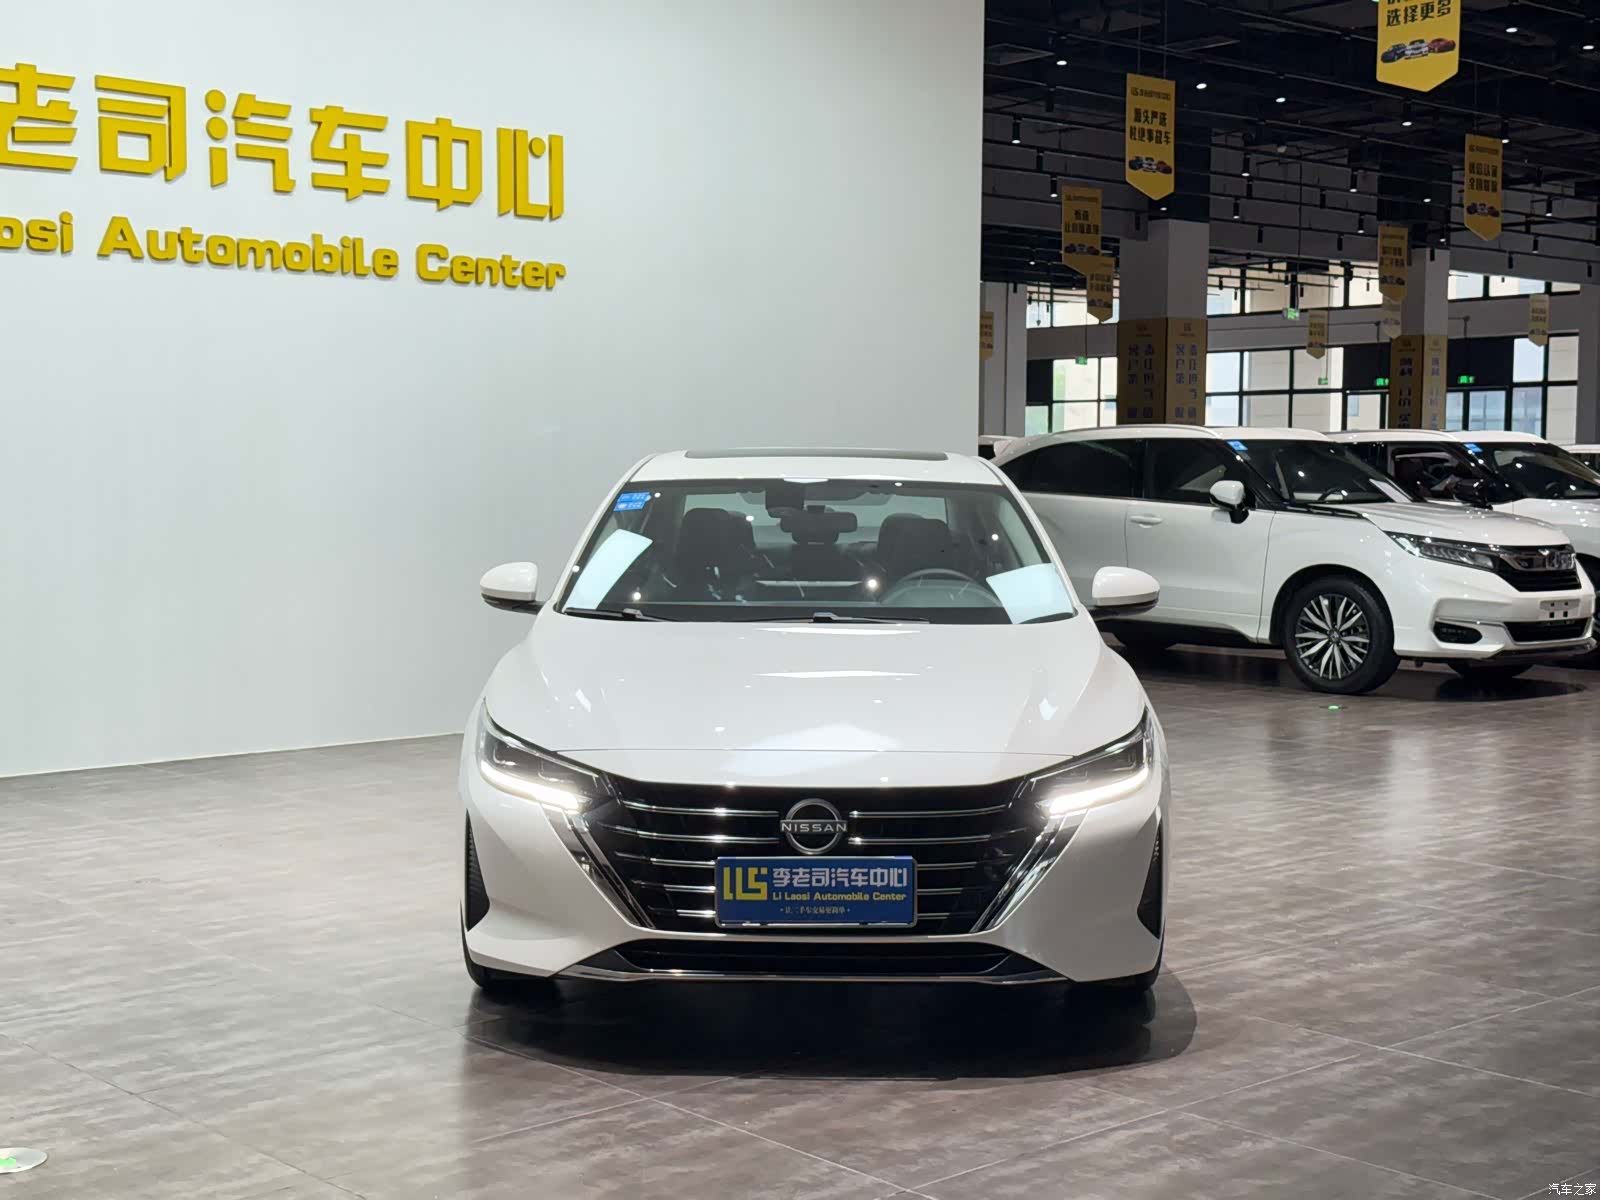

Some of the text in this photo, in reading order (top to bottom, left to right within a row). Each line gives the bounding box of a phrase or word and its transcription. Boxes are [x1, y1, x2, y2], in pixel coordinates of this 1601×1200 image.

[1386, 0, 1451, 27] 选择更多
[0, 63, 564, 221] 老司汽车中心
[97, 215, 399, 278] Automobile
[416, 243, 567, 290] Center
[781, 823, 847, 832] NISSAN
[772, 867, 908, 888] 李老司汽车中心
[773, 891, 907, 901] Li Laosi Automobile Center
